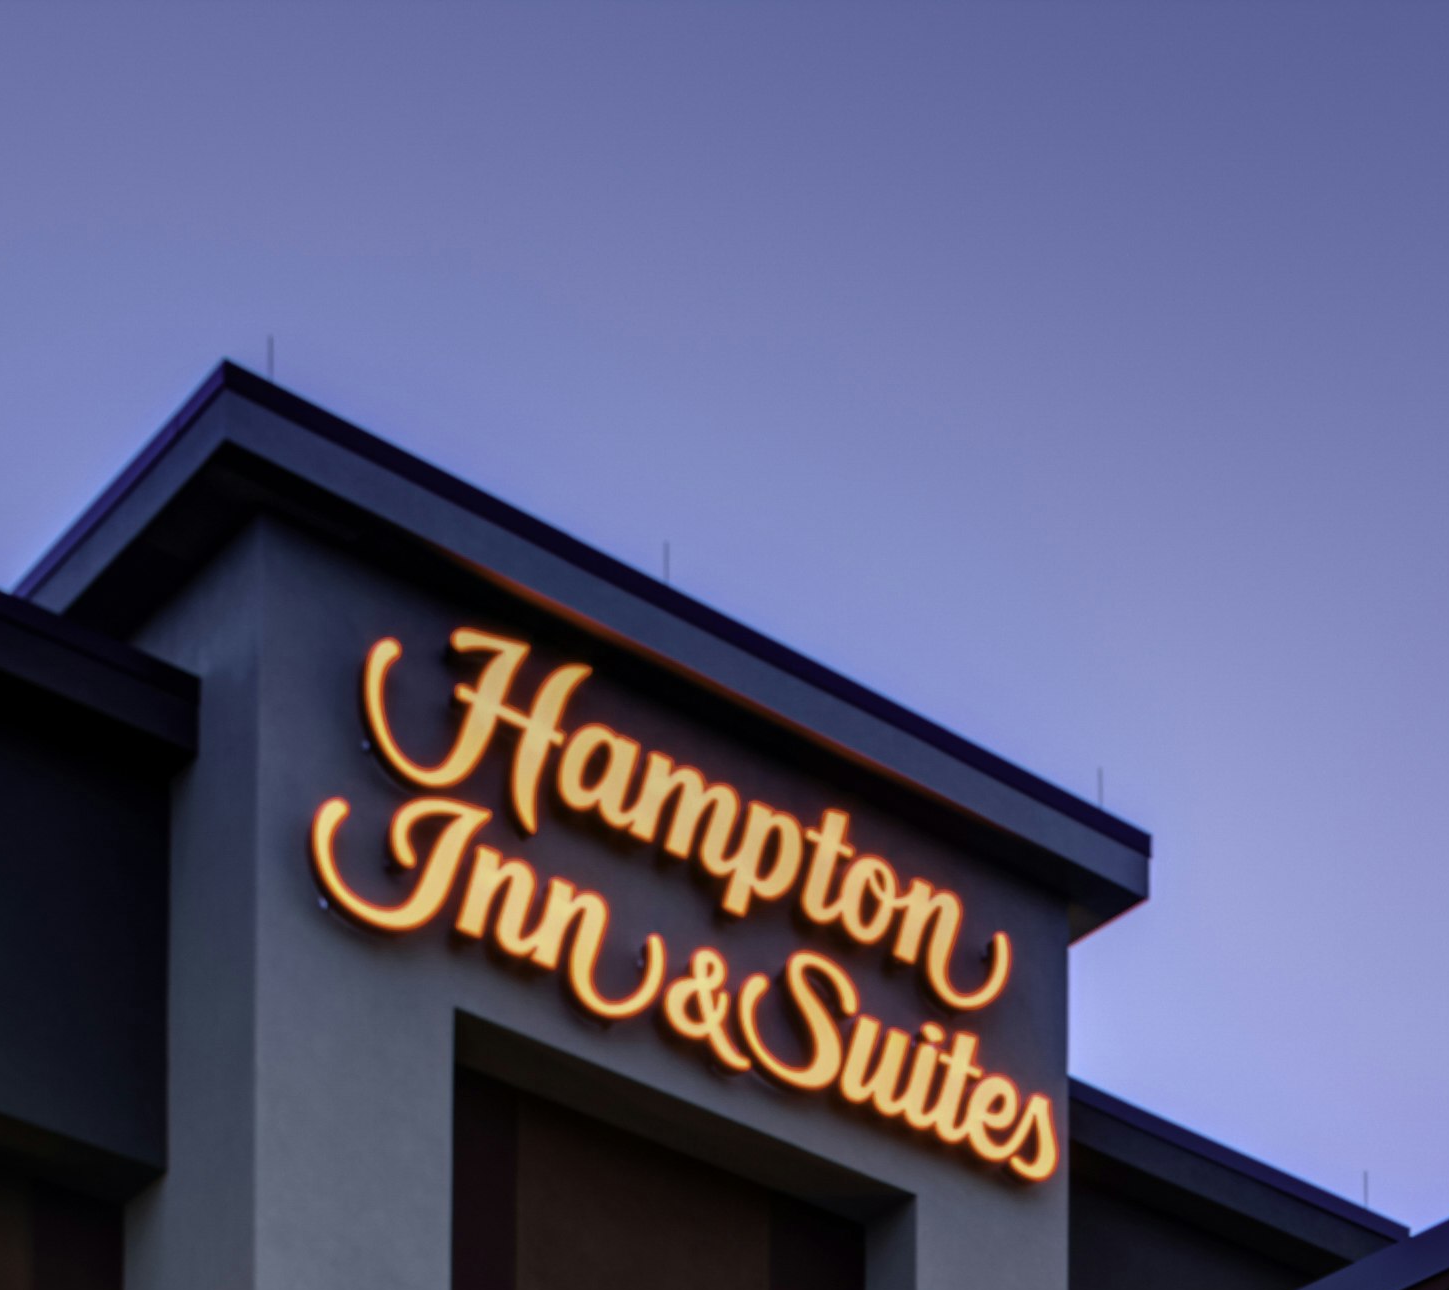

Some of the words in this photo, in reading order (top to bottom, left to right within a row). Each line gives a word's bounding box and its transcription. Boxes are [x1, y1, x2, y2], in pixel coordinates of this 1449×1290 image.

[312, 796, 668, 1018] Inn
[664, 946, 752, 1071] &
[738, 949, 1061, 1182] Suites
[365, 628, 1012, 1010] Hampton
